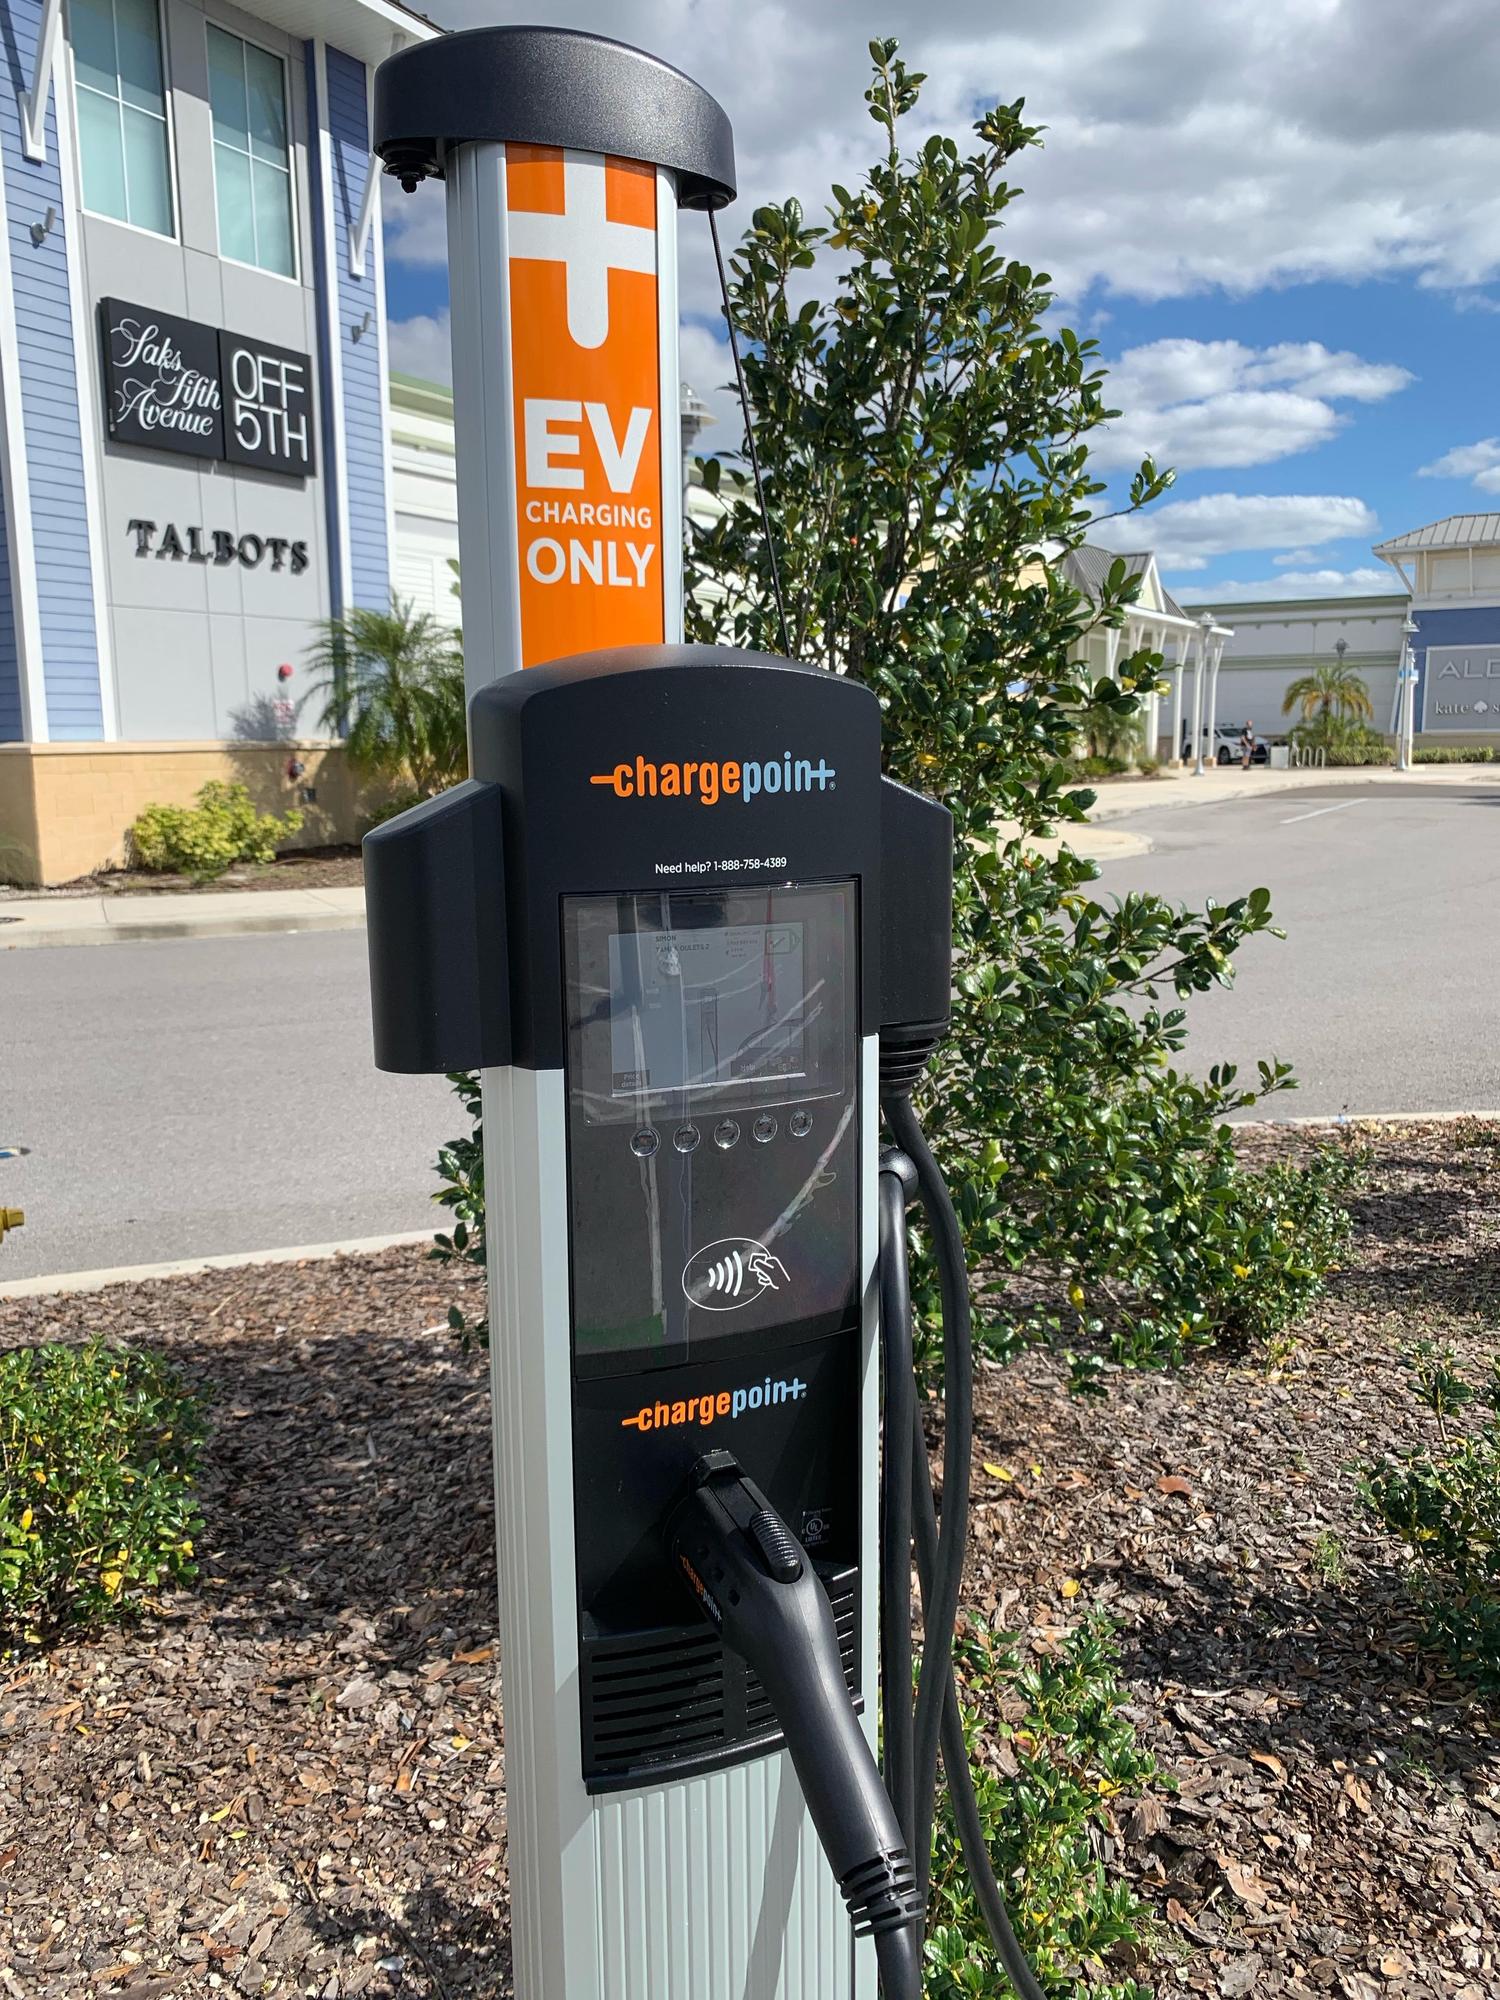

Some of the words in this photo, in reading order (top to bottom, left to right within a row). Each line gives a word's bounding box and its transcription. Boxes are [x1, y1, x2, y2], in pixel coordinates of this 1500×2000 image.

[109, 318, 181, 372] Saks
[113, 378, 214, 436] Avenue
[232, 350, 304, 409] OFF
[234, 399, 308, 462] 5TH
[524, 398, 653, 494] EV
[525, 500, 653, 529] CHARGING
[126, 518, 309, 575] TALBOTS
[526, 537, 655, 588] ONLY
[1435, 700, 1468, 714] kate
[589, 751, 836, 806] chargepoint
[655, 862, 683, 874] Need
[685, 860, 712, 874] help?
[713, 857, 787, 872] 1-888-758-4389
[621, 1376, 807, 1431] chargepoint
